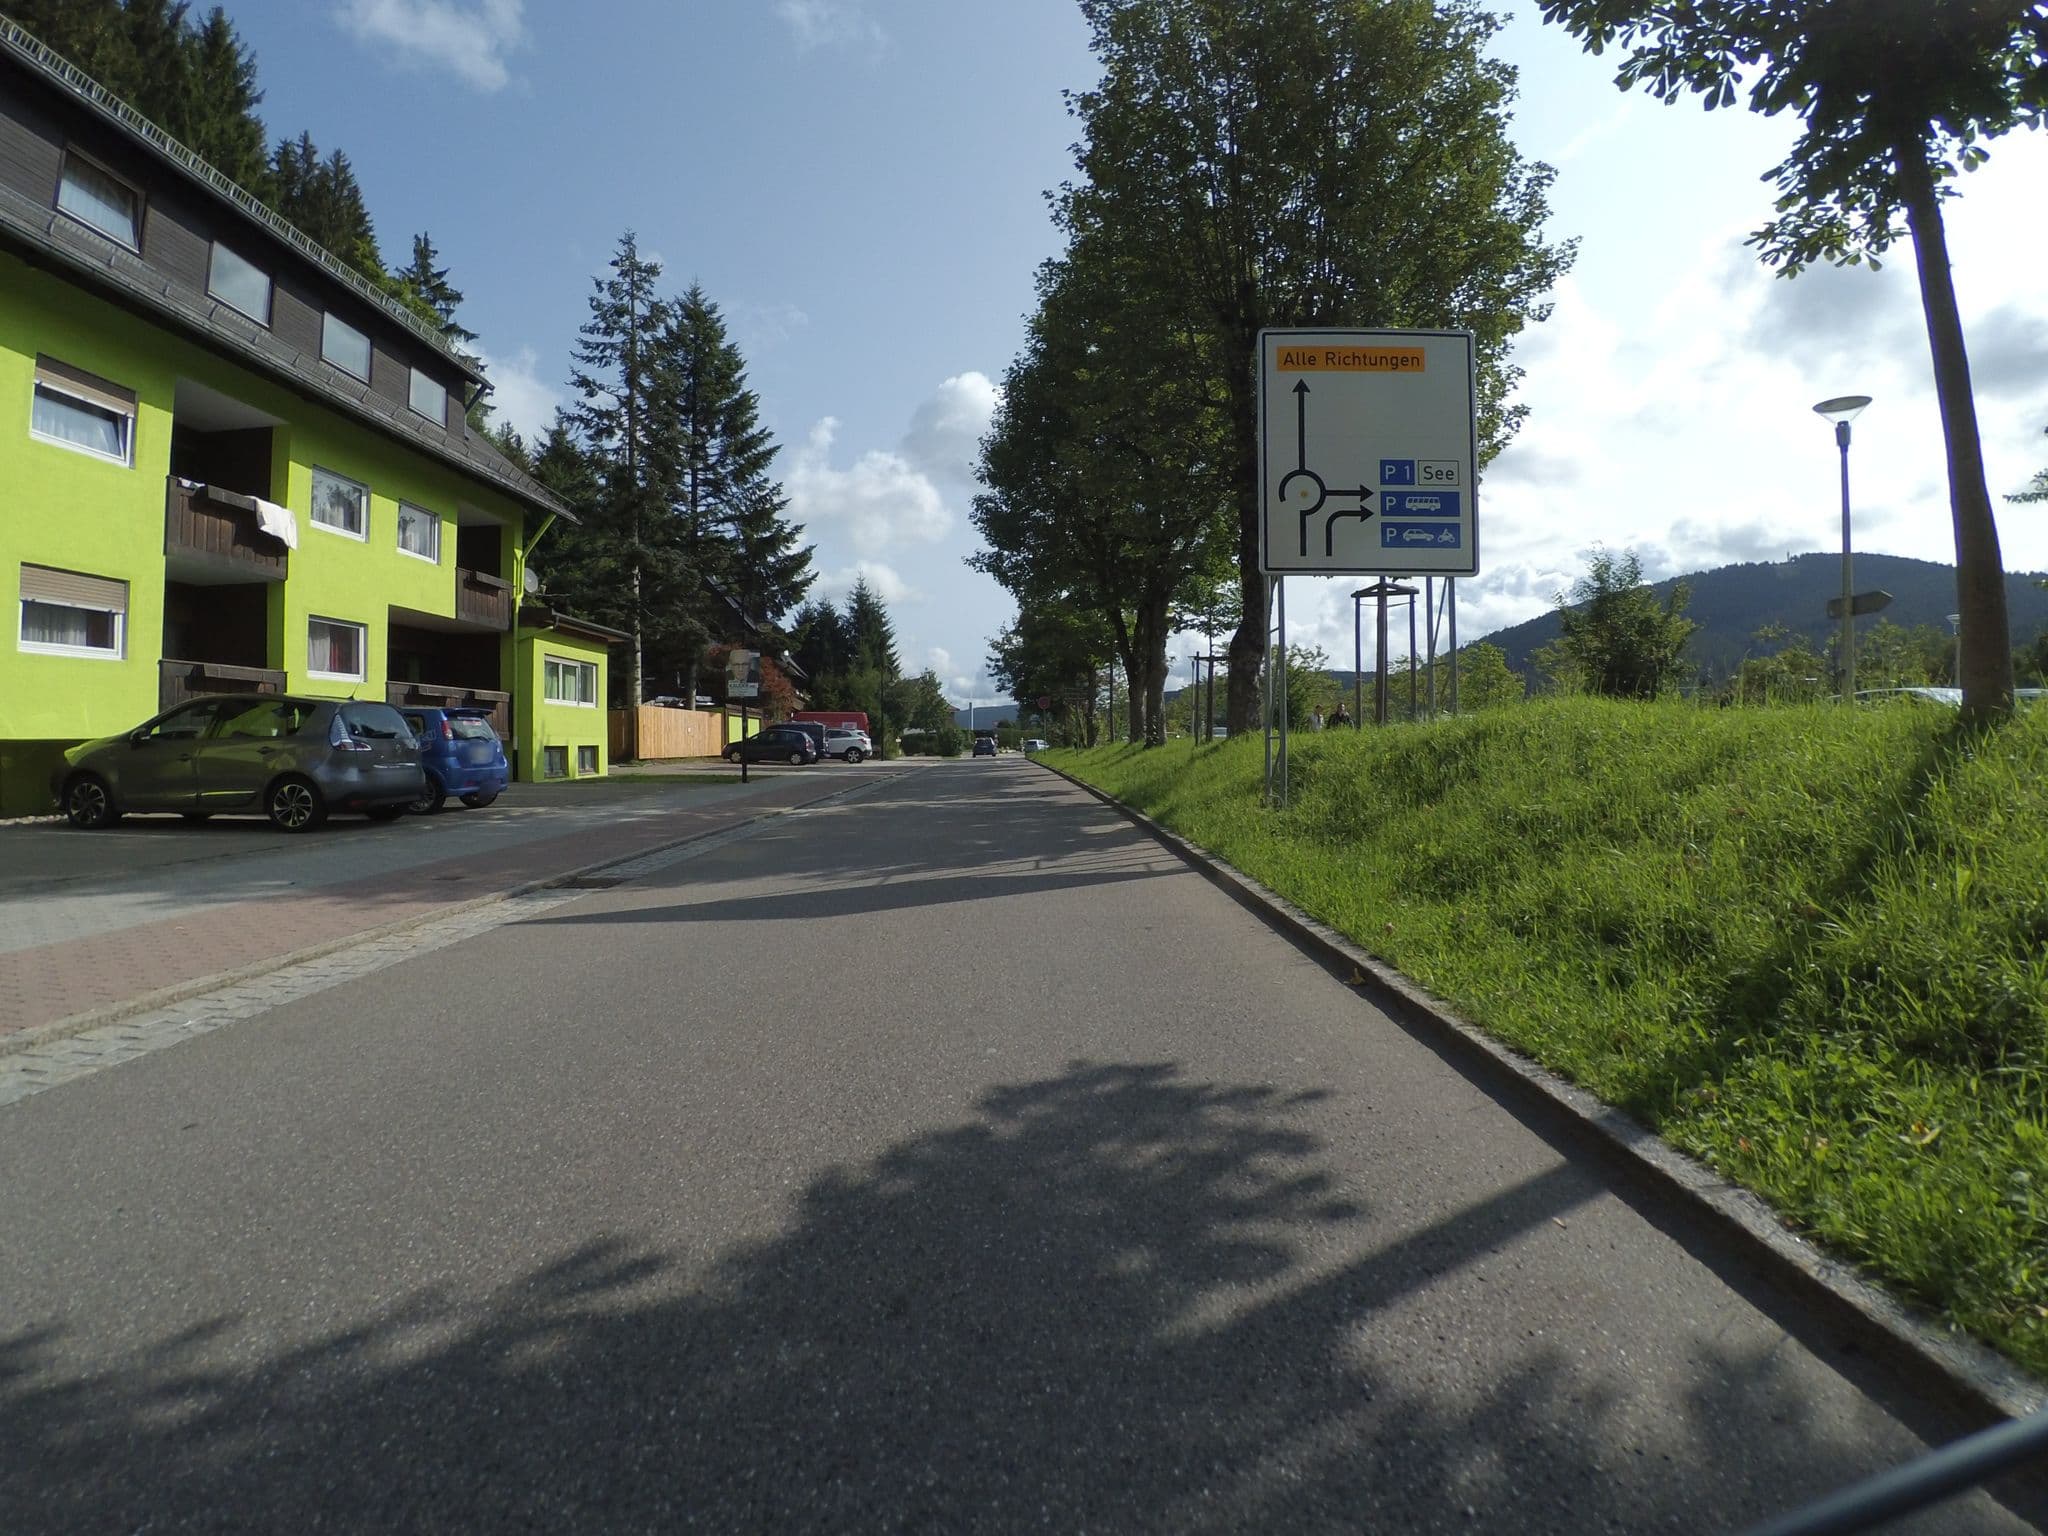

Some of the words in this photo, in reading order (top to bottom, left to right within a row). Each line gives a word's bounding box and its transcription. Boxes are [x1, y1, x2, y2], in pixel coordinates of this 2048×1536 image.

[1283, 351, 1317, 366] Alle
[1325, 351, 1421, 370] Richtungen
[1385, 465, 1396, 480] P
[1403, 465, 1411, 481] 1
[1423, 465, 1455, 481] See
[1385, 496, 1397, 511] P
[1386, 528, 1398, 543] P
